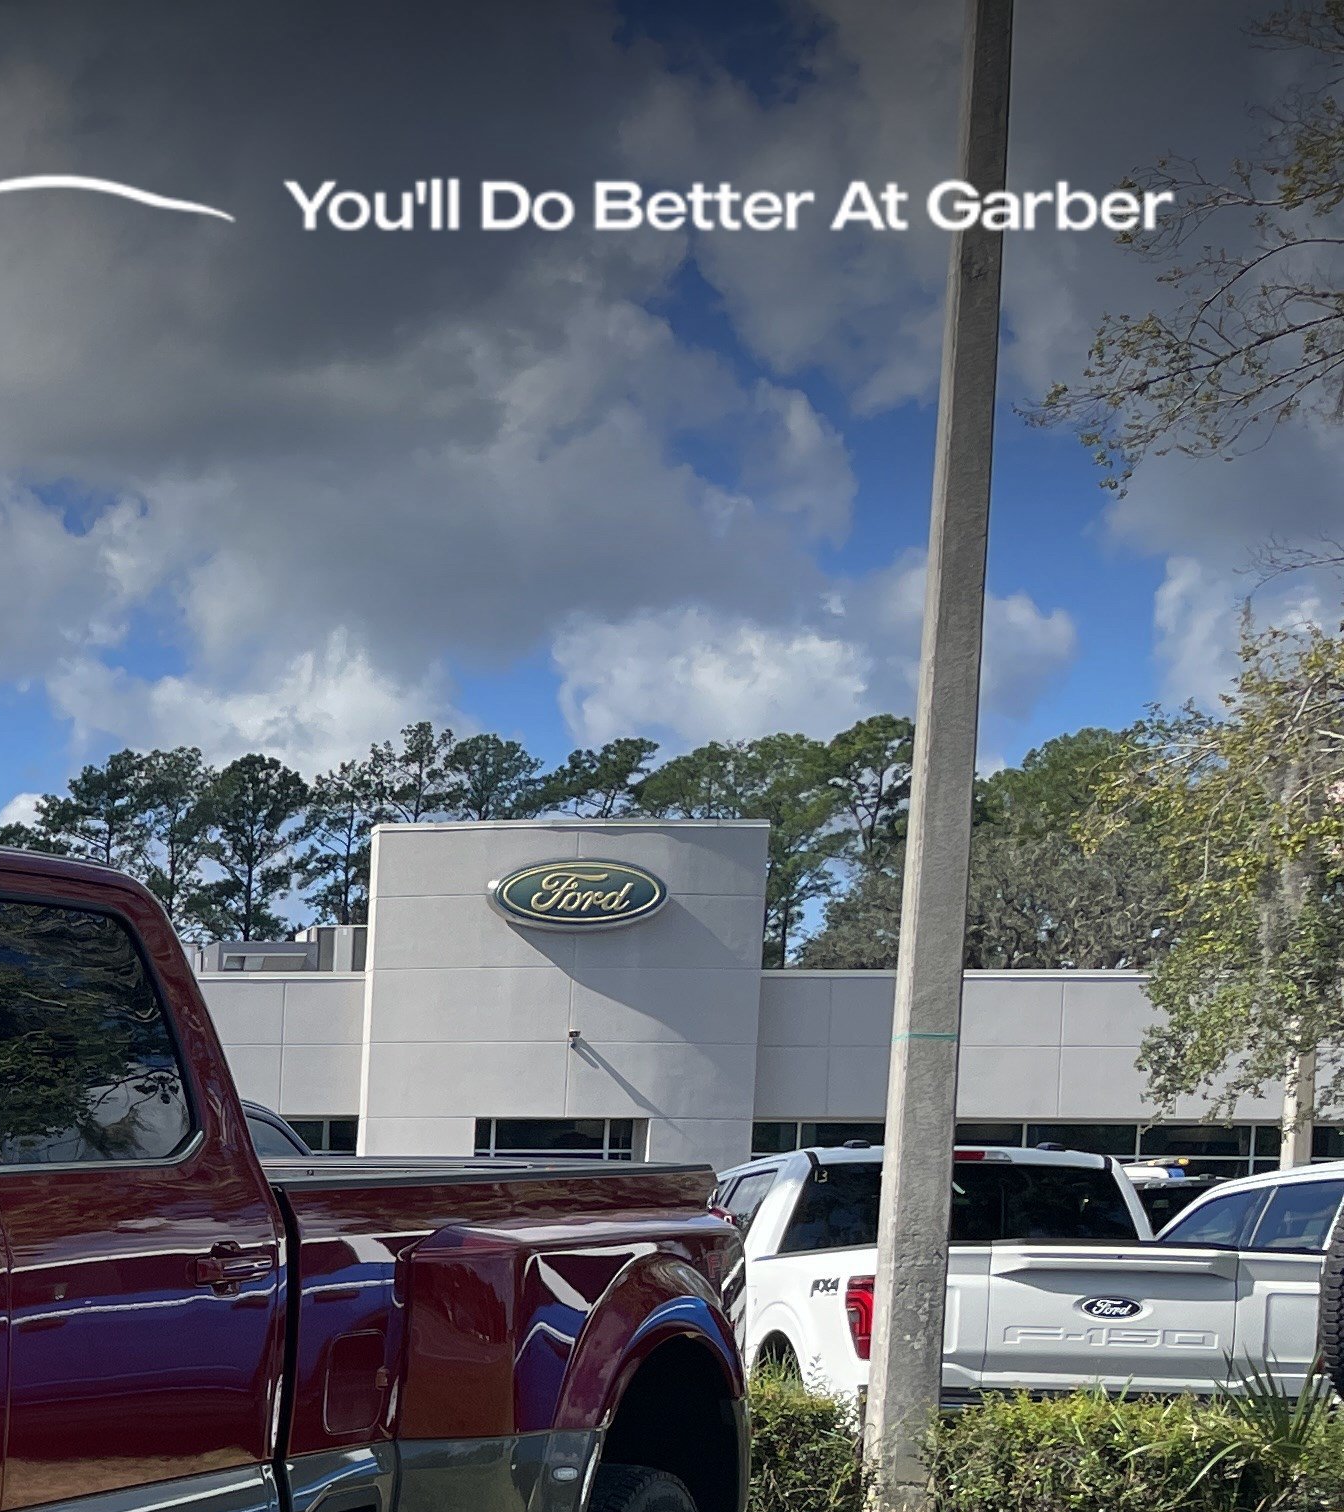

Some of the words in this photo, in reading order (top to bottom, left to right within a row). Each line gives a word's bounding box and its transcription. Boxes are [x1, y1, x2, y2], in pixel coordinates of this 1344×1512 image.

[531, 872, 635, 912] Ford
[811, 1277, 841, 1298] FX4
[1091, 1299, 1131, 1317] Ford
[1003, 1325, 1219, 1350] F-150
